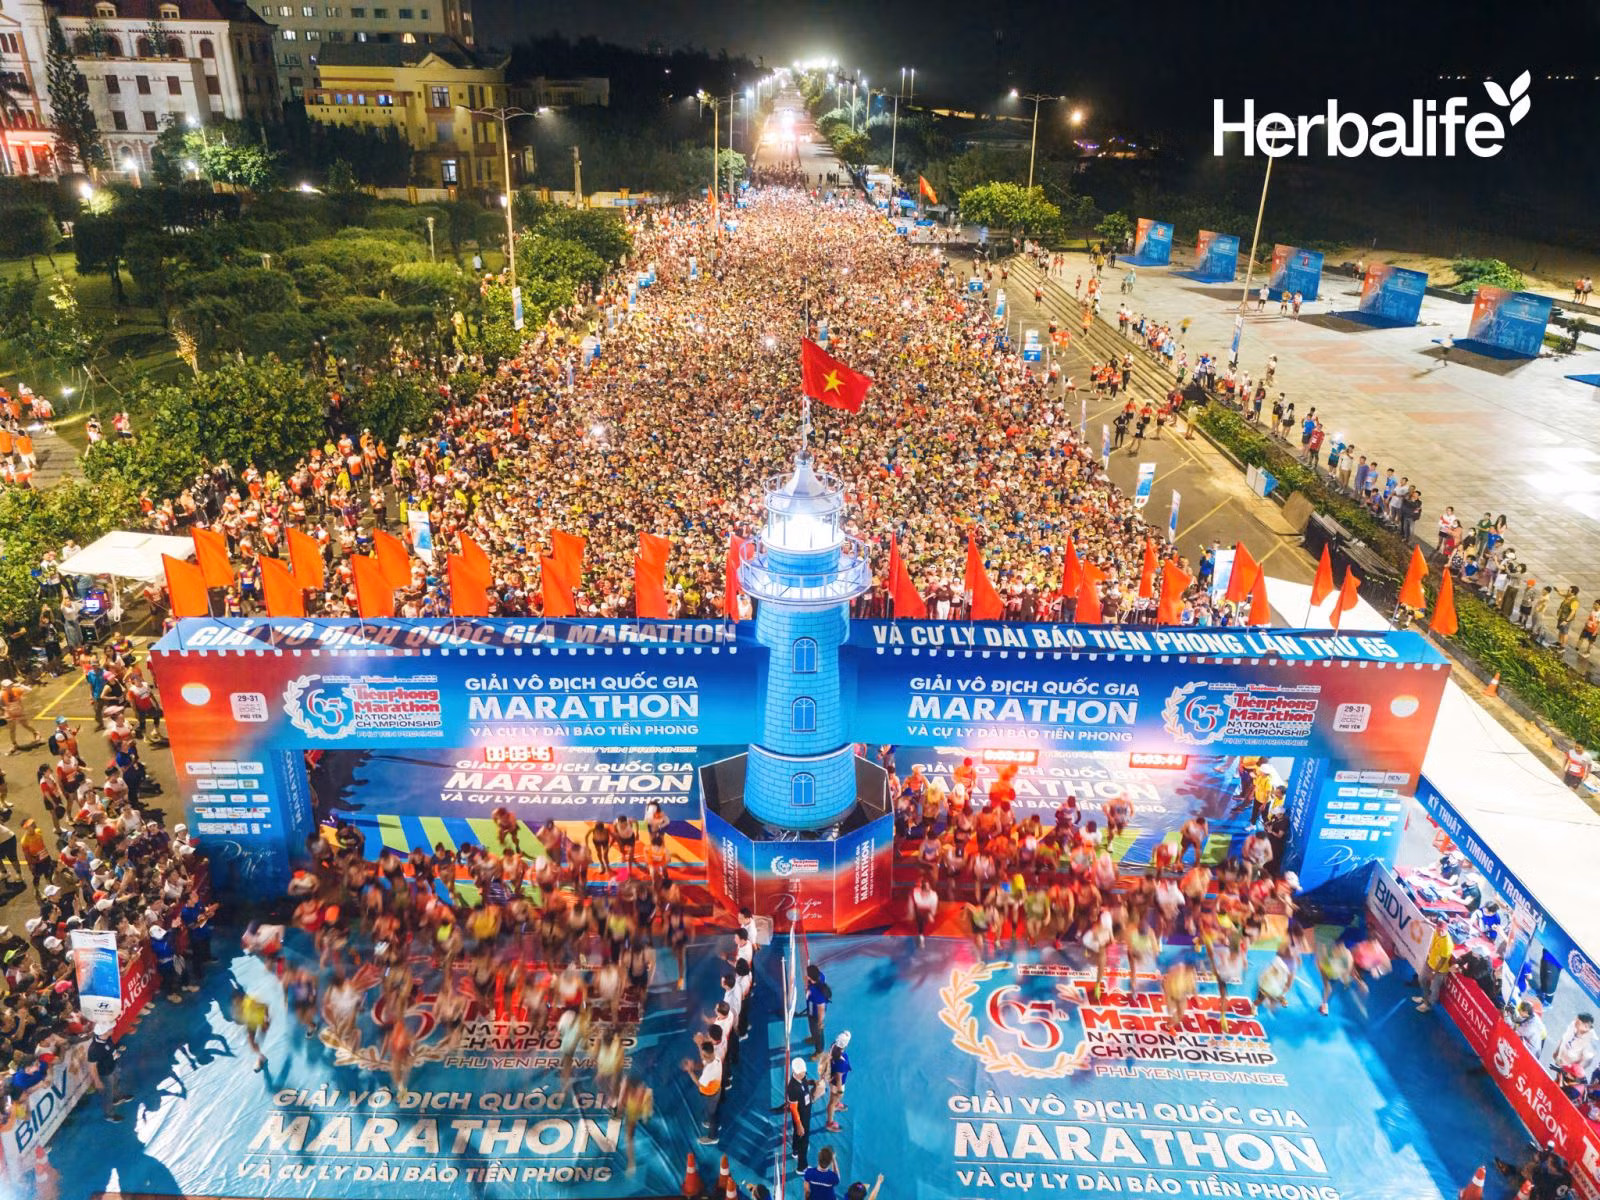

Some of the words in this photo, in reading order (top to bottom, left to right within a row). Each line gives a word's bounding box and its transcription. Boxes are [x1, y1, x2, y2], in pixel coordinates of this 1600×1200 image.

[186, 620, 264, 646] GIẢI
[273, 622, 314, 646] VÔ
[319, 625, 396, 649] ĐỊCH
[404, 618, 495, 645] QUỐC
[502, 624, 555, 644] GIA
[566, 624, 737, 644] MARATHON
[873, 622, 904, 645] VÀ
[911, 625, 944, 649] CỰ
[950, 626, 975, 646] LY
[983, 624, 1027, 648] DÀI
[1032, 626, 1082, 648] BÁO
[1155, 631, 1245, 655] PHONG
[1356, 637, 1399, 658] 65
[465, 674, 508, 691] GIẢI
[513, 674, 544, 691] VÔ
[548, 677, 596, 693] ĐỊCH
[600, 671, 658, 690] QUỐC
[663, 676, 699, 690] GIA
[910, 674, 952, 691] GIẢI
[957, 675, 986, 692] VÔ
[991, 680, 1037, 696] ĐỊCH
[1042, 677, 1099, 695] QUỐC
[1104, 682, 1139, 696] GIA
[237, 694, 258, 702] 29-31
[307, 688, 343, 726] 65
[354, 701, 440, 712] Marathon
[468, 695, 699, 720] MARATHON
[908, 696, 1138, 724] MARATHON
[356, 720, 441, 728] CHAMPIONSHIP
[1186, 695, 1219, 732] 65
[1227, 721, 1282, 729] NATIONAL
[1229, 709, 1313, 722] Marathon
[470, 725, 494, 737] VÀ
[497, 726, 518, 738] CỰ
[522, 727, 543, 737] LY
[545, 725, 570, 737] DÀI
[573, 724, 606, 737] BÁO
[609, 722, 641, 736] TIỀN
[645, 725, 699, 736] PHONG
[907, 725, 928, 737] VÀ
[932, 726, 952, 738] CỰ
[956, 727, 974, 738] LY
[1042, 726, 1074, 740] TIỀN
[1078, 731, 1132, 742] PHONG
[1226, 728, 1309, 736] CHAMPIONSHIP
[594, 759, 653, 772] QUỐC
[658, 763, 694, 773] GIA
[1049, 765, 1109, 779] QUỐC
[444, 772, 694, 793] MARATHON
[440, 791, 466, 802] VÀ
[495, 794, 516, 803] LY
[518, 791, 548, 804] DÀI
[551, 793, 588, 805] BÁO
[1427, 793, 1441, 811] KỸ
[1438, 804, 1462, 838] THUẬT
[1465, 835, 1494, 874] TIMING
[860, 840, 870, 901] MARATHON
[1375, 879, 1412, 930] BIDV
[128, 972, 141, 991] BIA
[1081, 1008, 1265, 1037] Marathon
[1087, 1031, 1208, 1048] NATIONAL
[1091, 1045, 1274, 1065] CHAMPIONSHIP
[1186, 1070, 1286, 1086] PROVINCE
[273, 1083, 339, 1109] GIẢI
[347, 1086, 393, 1109] VÔ
[400, 1090, 471, 1114] ĐỊCH
[478, 1085, 566, 1110] QUỐC
[949, 1090, 1012, 1115] GIẢI
[1019, 1093, 1066, 1116] VÔ
[1073, 1099, 1147, 1122] ĐỊCH
[1154, 1099, 1244, 1125] QUỐC
[1251, 1108, 1310, 1129] GIA
[1536, 1087, 1553, 1112] BIA
[15, 1070, 67, 1154] BIDV
[1515, 1076, 1567, 1147] SAIGON
[249, 1115, 622, 1155] MARATHON
[954, 1122, 1329, 1174] MARATHON
[236, 1159, 272, 1179] VÀ
[277, 1163, 316, 1180] CỰ
[318, 1164, 351, 1181] LY
[353, 1160, 399, 1182] DÀI
[404, 1161, 458, 1183] BÁO
[464, 1160, 518, 1183] TIỀN
[522, 1166, 613, 1182] PHONG
[956, 1167, 994, 1188] VÀ
[1000, 1171, 1035, 1193] CỰ
[1040, 1173, 1071, 1191] LY
[1076, 1170, 1122, 1193] DÀI
[1128, 1172, 1182, 1195] BÁO
[1187, 1173, 1243, 1198] TIỀN
[1248, 1182, 1341, 1200] PHONG
